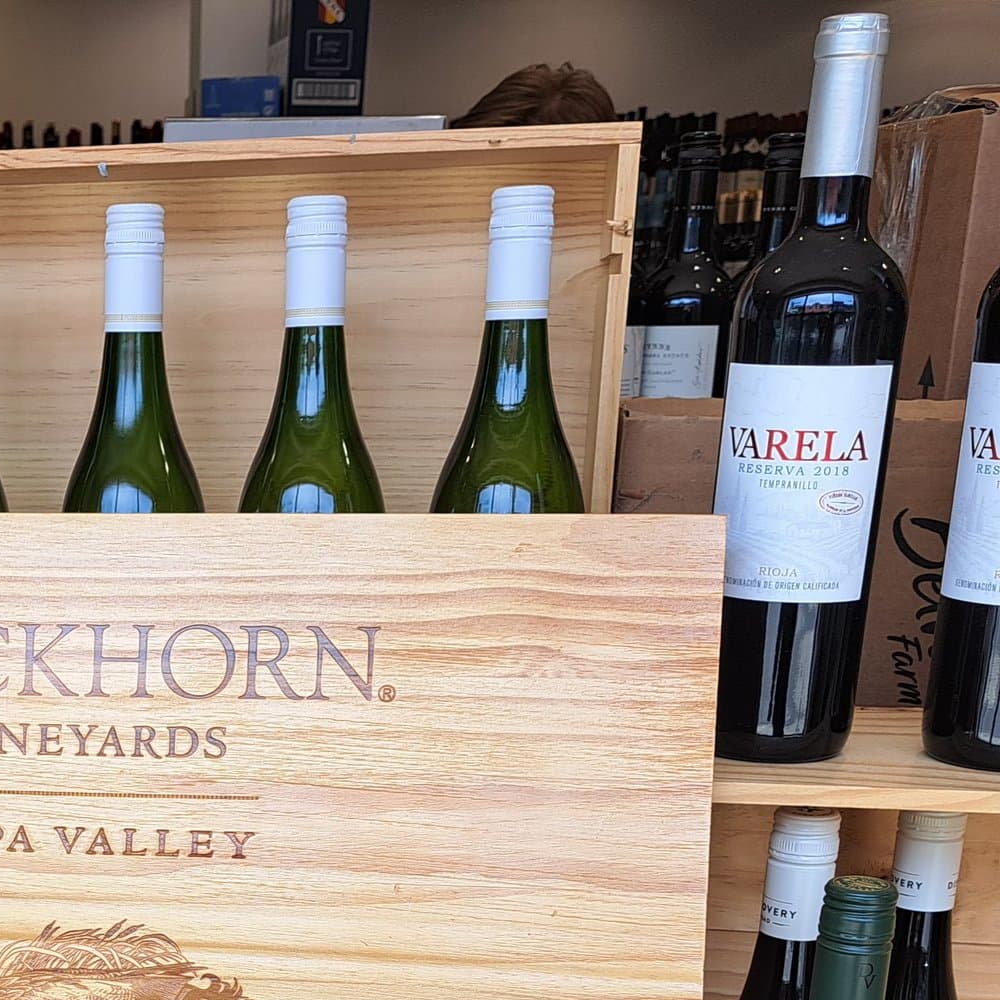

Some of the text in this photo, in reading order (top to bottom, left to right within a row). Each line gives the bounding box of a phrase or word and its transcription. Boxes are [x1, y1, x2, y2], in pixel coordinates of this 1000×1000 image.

[729, 426, 869, 462] VARELA
[738, 462, 850, 477] RESERVA 2018
[759, 478, 818, 490] TEMPRANILLO
[759, 566, 798, 578] RIOJA
[774, 581, 800, 590] ORIGEN
[802, 581, 839, 591] CALIFICADA
[886, 634, 922, 704] Farm
[53, 825, 255, 860] VALLEY
